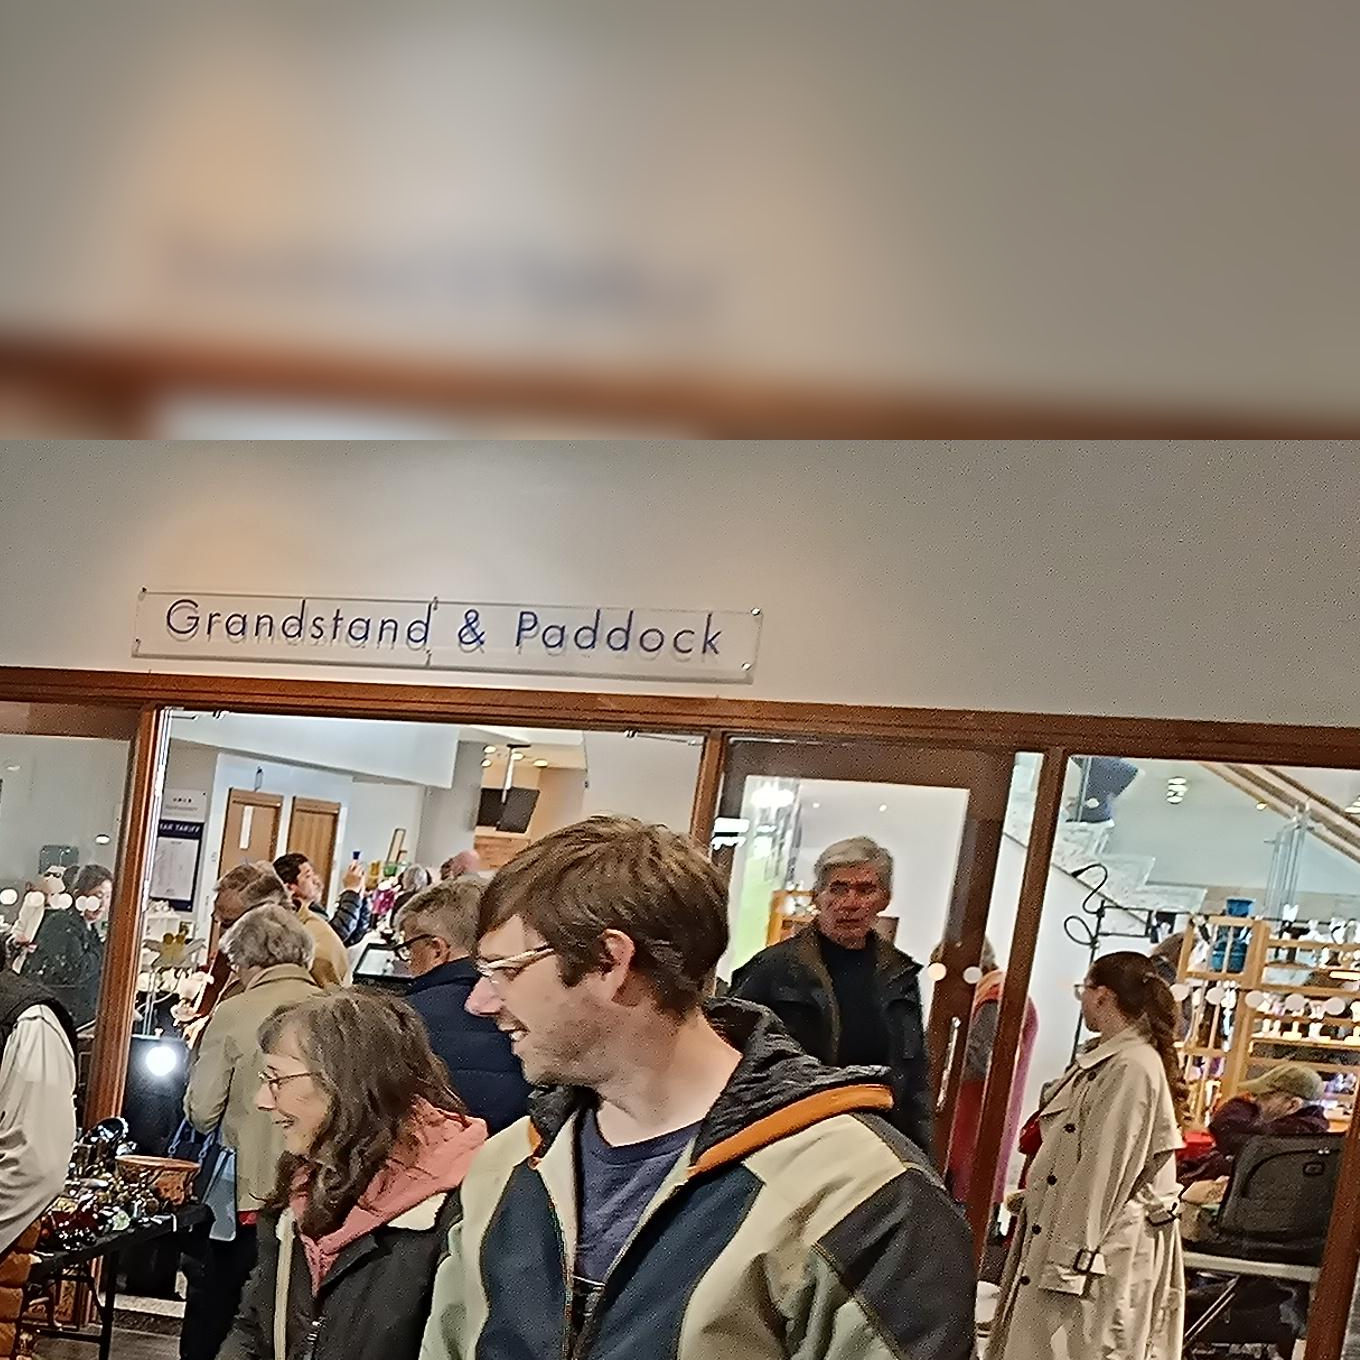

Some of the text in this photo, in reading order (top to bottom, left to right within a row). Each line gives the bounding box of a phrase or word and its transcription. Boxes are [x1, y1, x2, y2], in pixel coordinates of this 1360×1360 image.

[166, 599, 722, 655] Grandstand & Paddock
